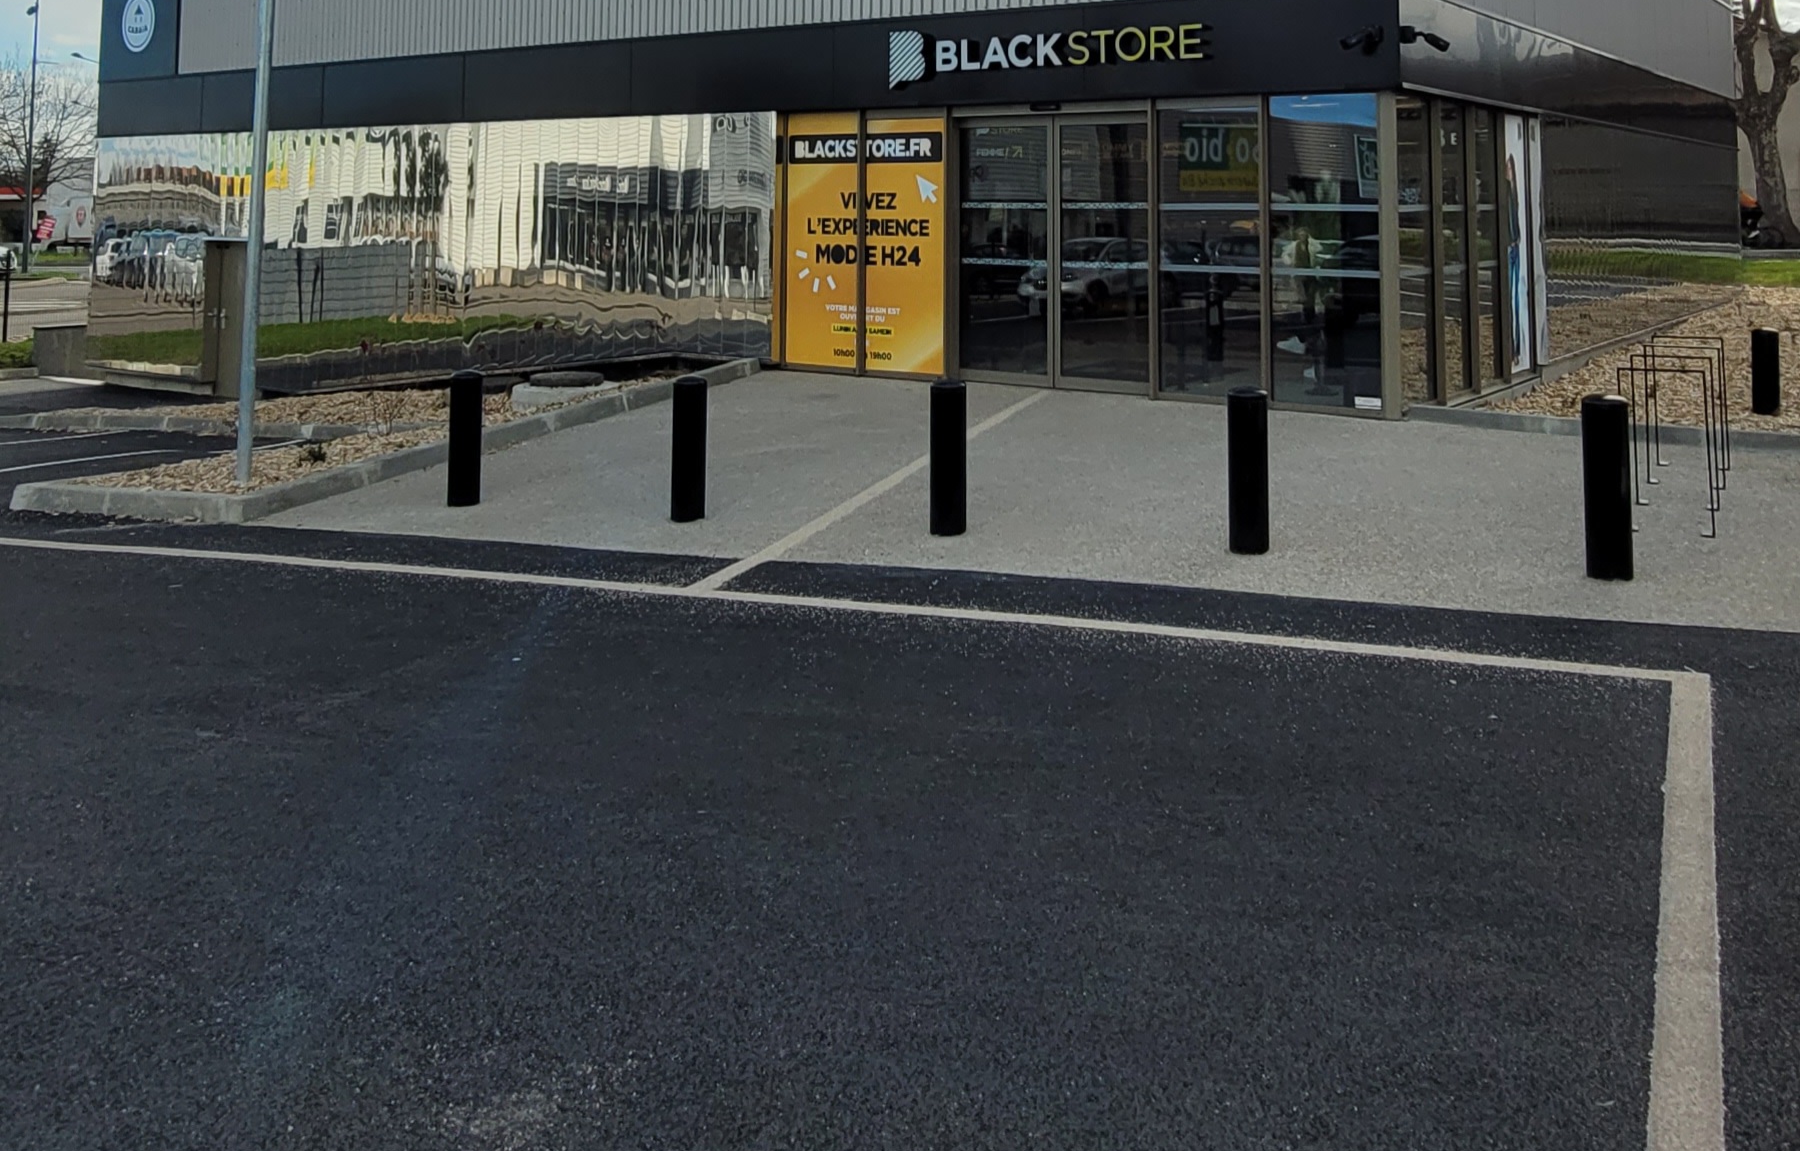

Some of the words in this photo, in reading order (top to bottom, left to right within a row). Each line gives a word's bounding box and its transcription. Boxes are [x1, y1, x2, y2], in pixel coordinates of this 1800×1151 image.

[935, 23, 1203, 72] BLACKSTORE
[794, 138, 932, 159] BLACKSTORE.FR
[840, 192, 897, 210] VIVEZ
[816, 243, 877, 265] MODE
[881, 246, 921, 266] H24
